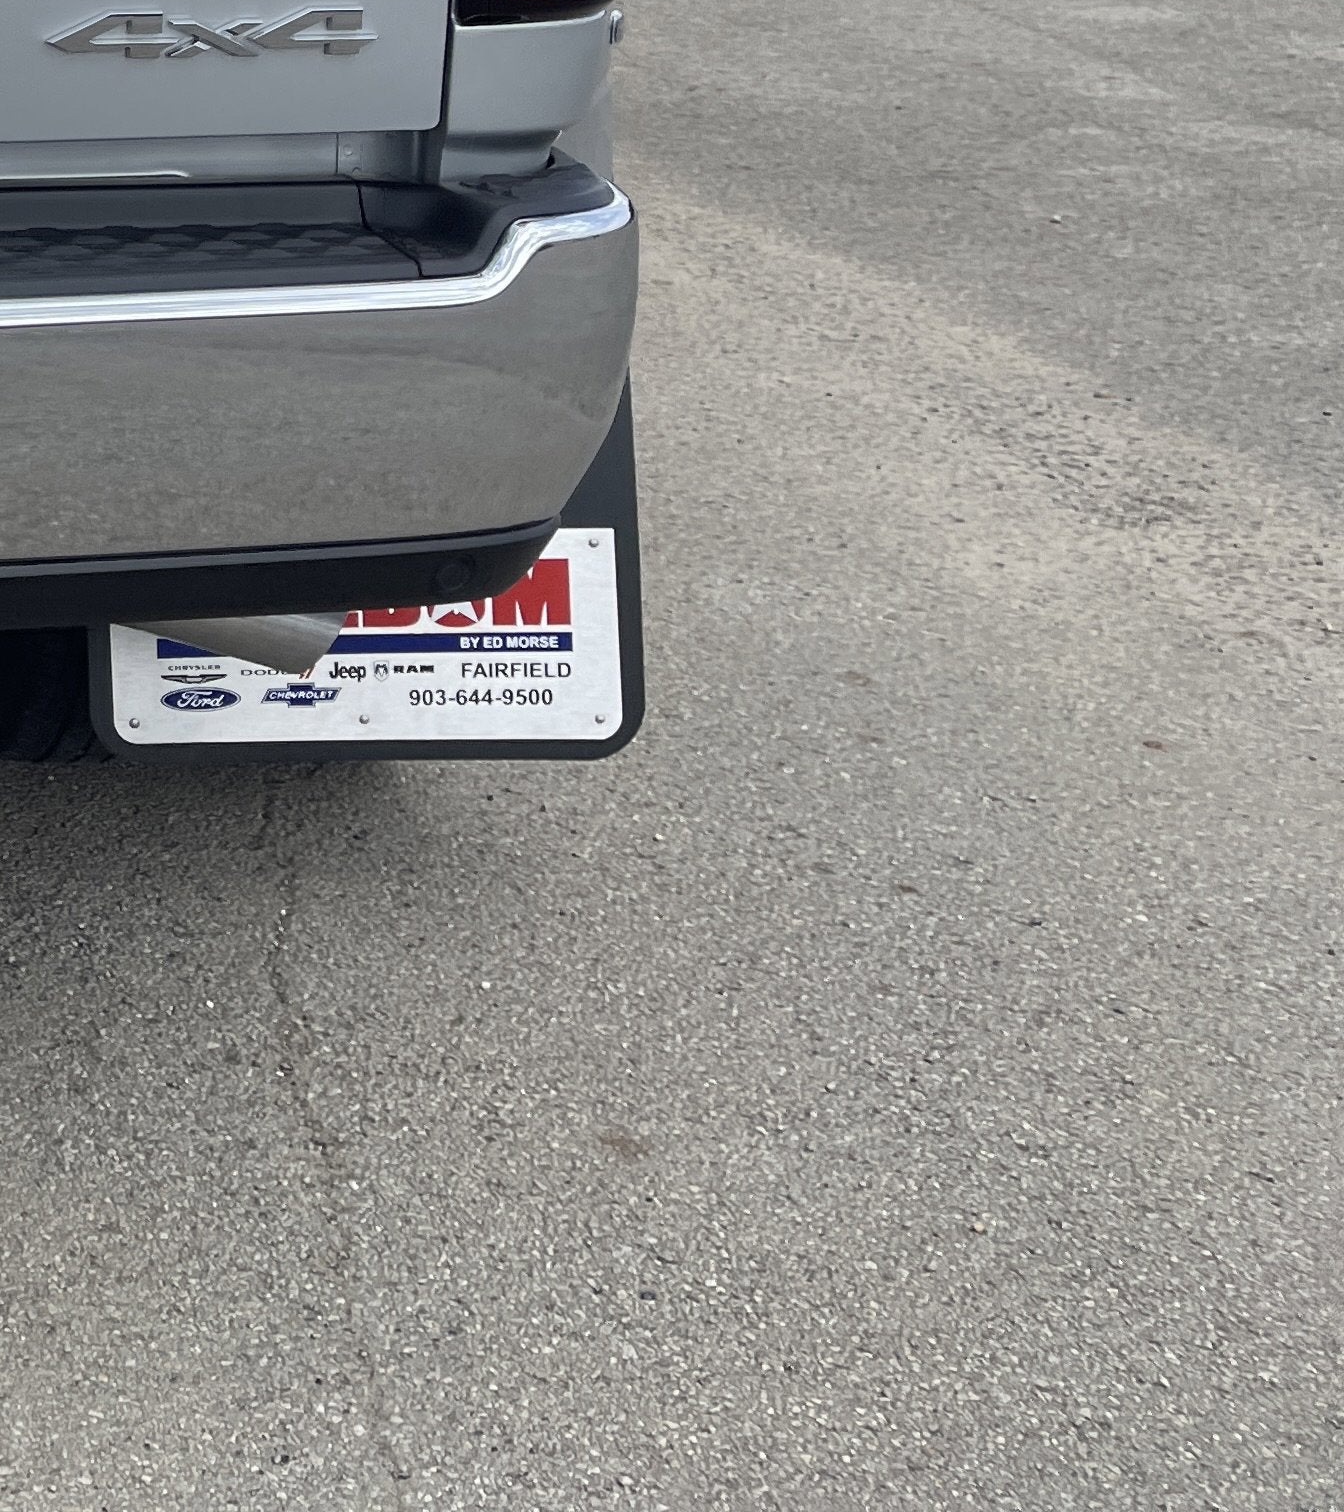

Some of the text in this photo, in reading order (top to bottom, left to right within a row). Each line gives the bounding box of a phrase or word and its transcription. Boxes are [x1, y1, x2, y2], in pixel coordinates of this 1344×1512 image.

[460, 635, 559, 649] BY ED MORSE
[329, 661, 366, 682] Jeep
[393, 664, 435, 673] RAM
[462, 662, 571, 678] FAIRFIELD
[177, 690, 224, 709] Ford
[269, 690, 334, 700] CHEVROLET
[409, 688, 553, 706] 903-644-9500
